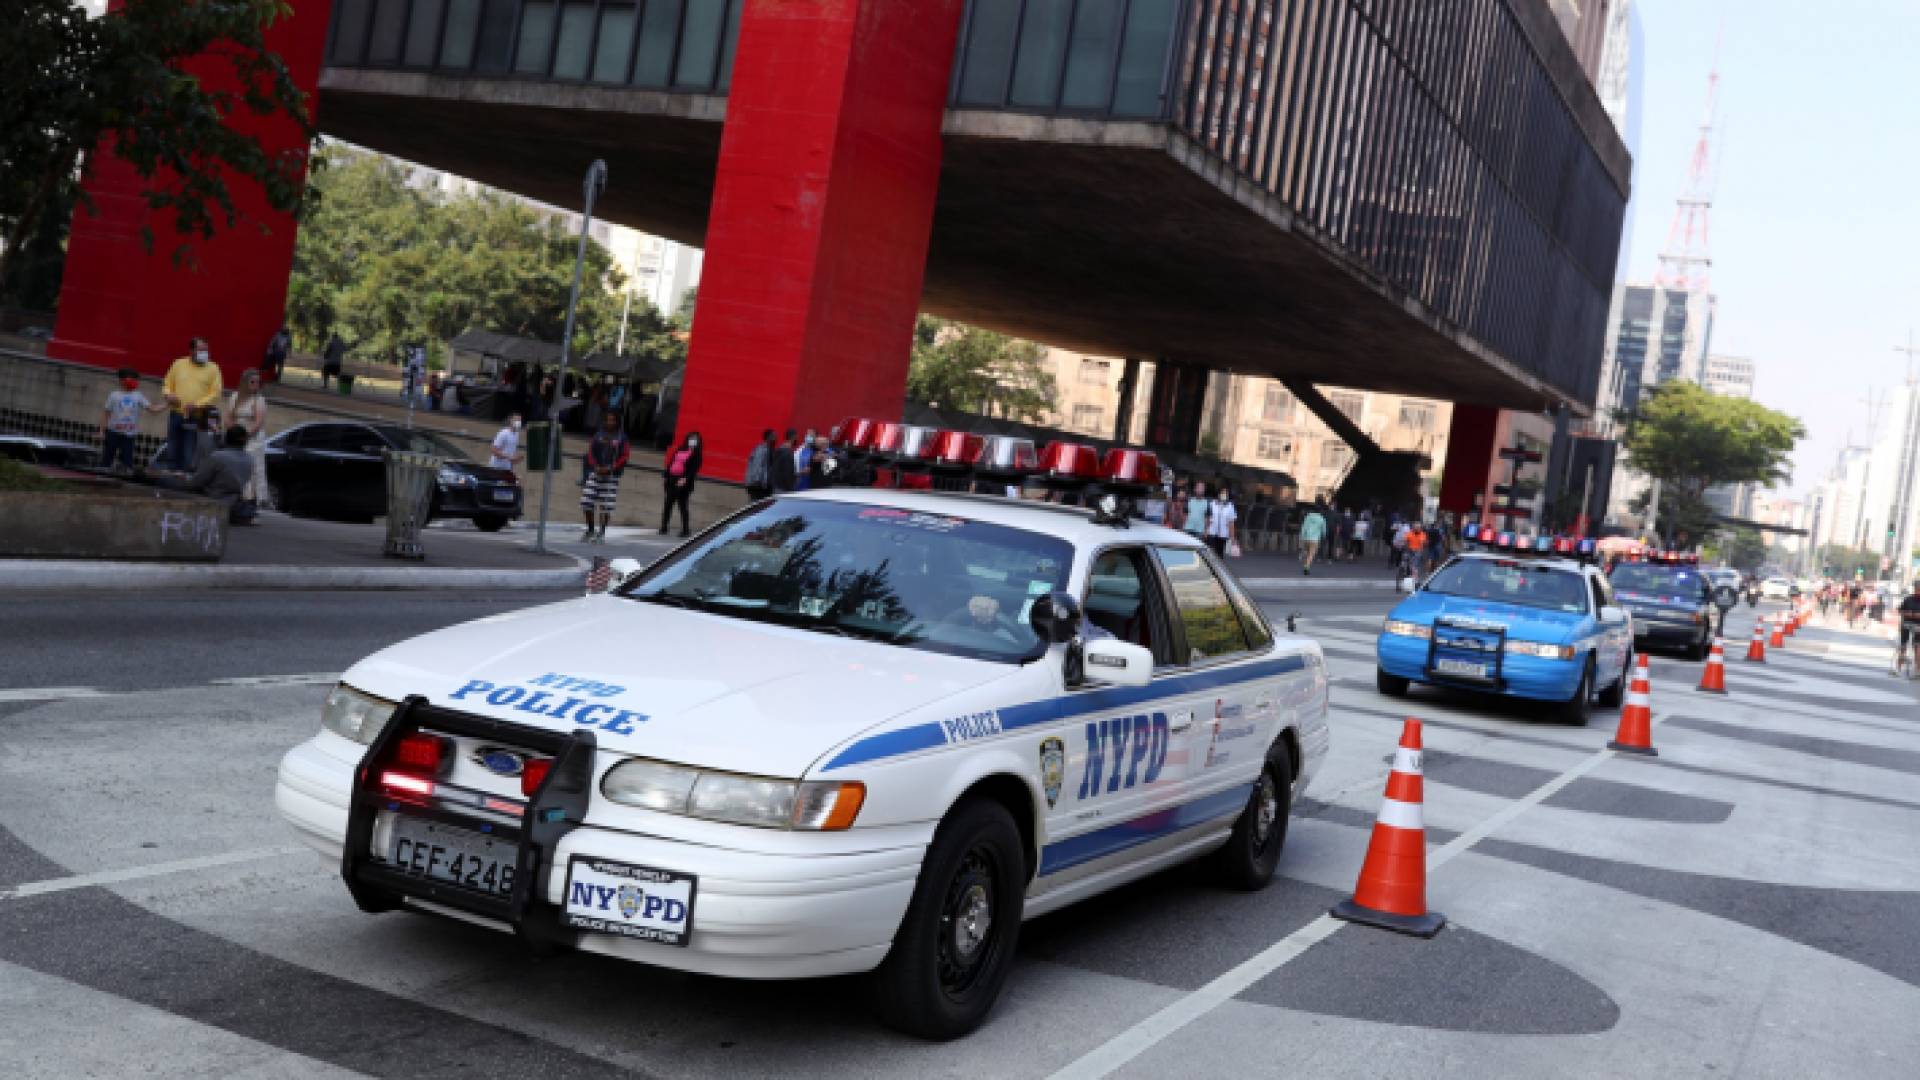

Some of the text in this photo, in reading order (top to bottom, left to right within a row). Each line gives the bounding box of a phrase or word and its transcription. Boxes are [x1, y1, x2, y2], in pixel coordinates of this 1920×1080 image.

[448, 679, 652, 736] POLICE
[526, 672, 627, 697] NYPD
[944, 708, 1000, 743] POLICE
[1077, 711, 1168, 800] NYPD
